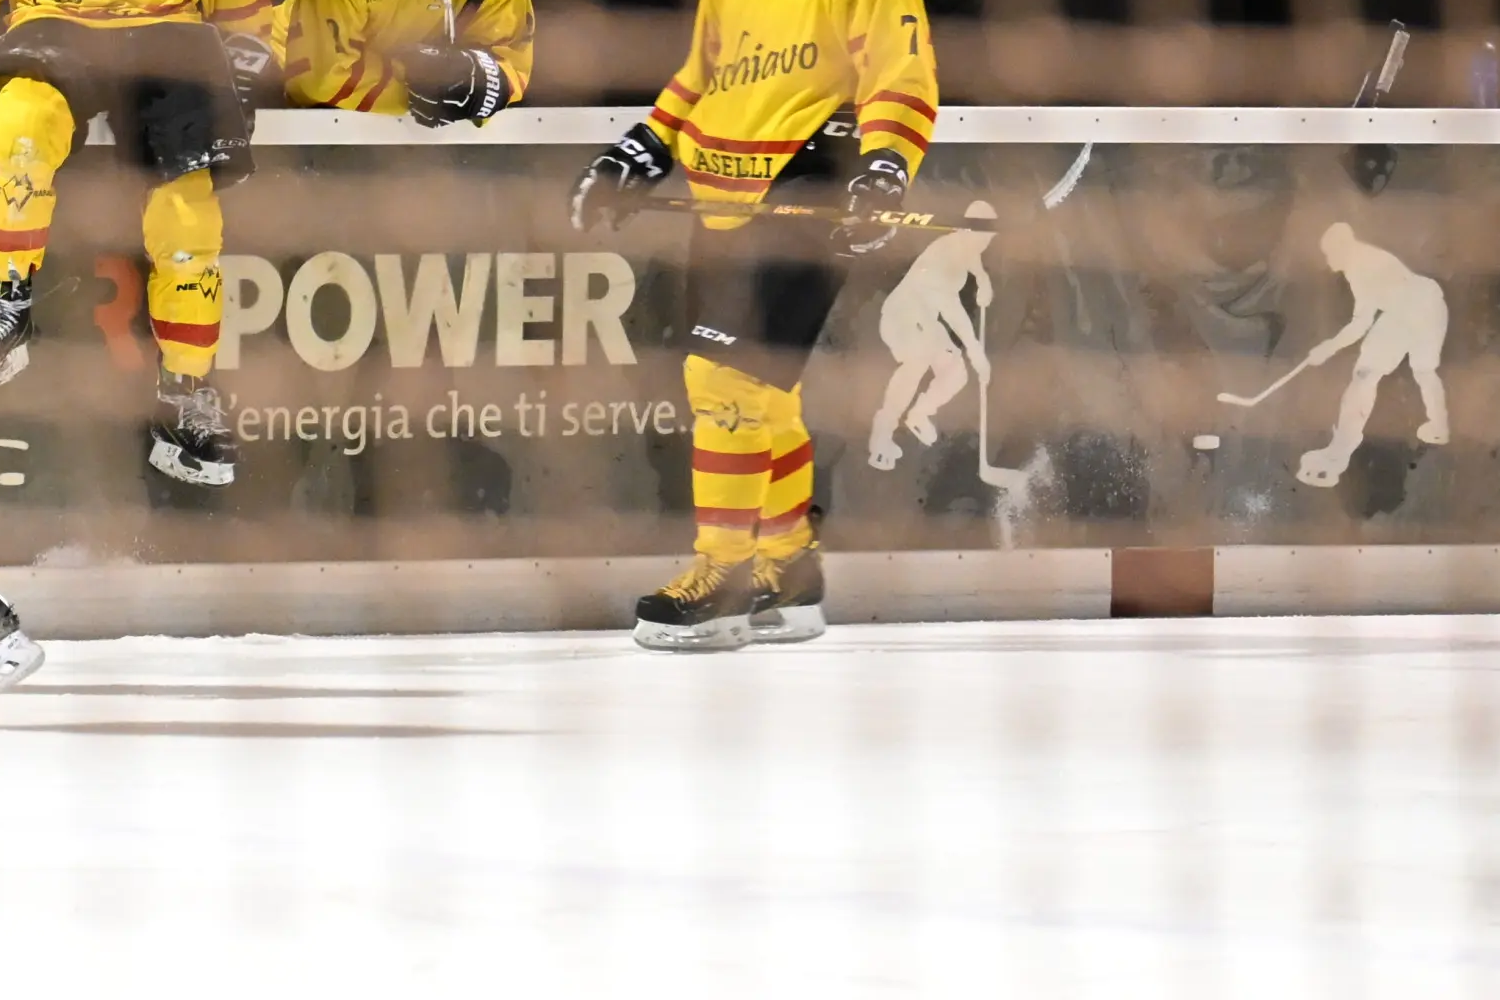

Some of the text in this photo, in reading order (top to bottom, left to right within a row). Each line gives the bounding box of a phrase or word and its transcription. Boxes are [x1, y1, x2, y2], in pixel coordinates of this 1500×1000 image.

[707, 31, 818, 96] schiavo
[94, 251, 638, 371] RPOWER
[426, 390, 503, 437] che
[514, 390, 547, 436] ti
